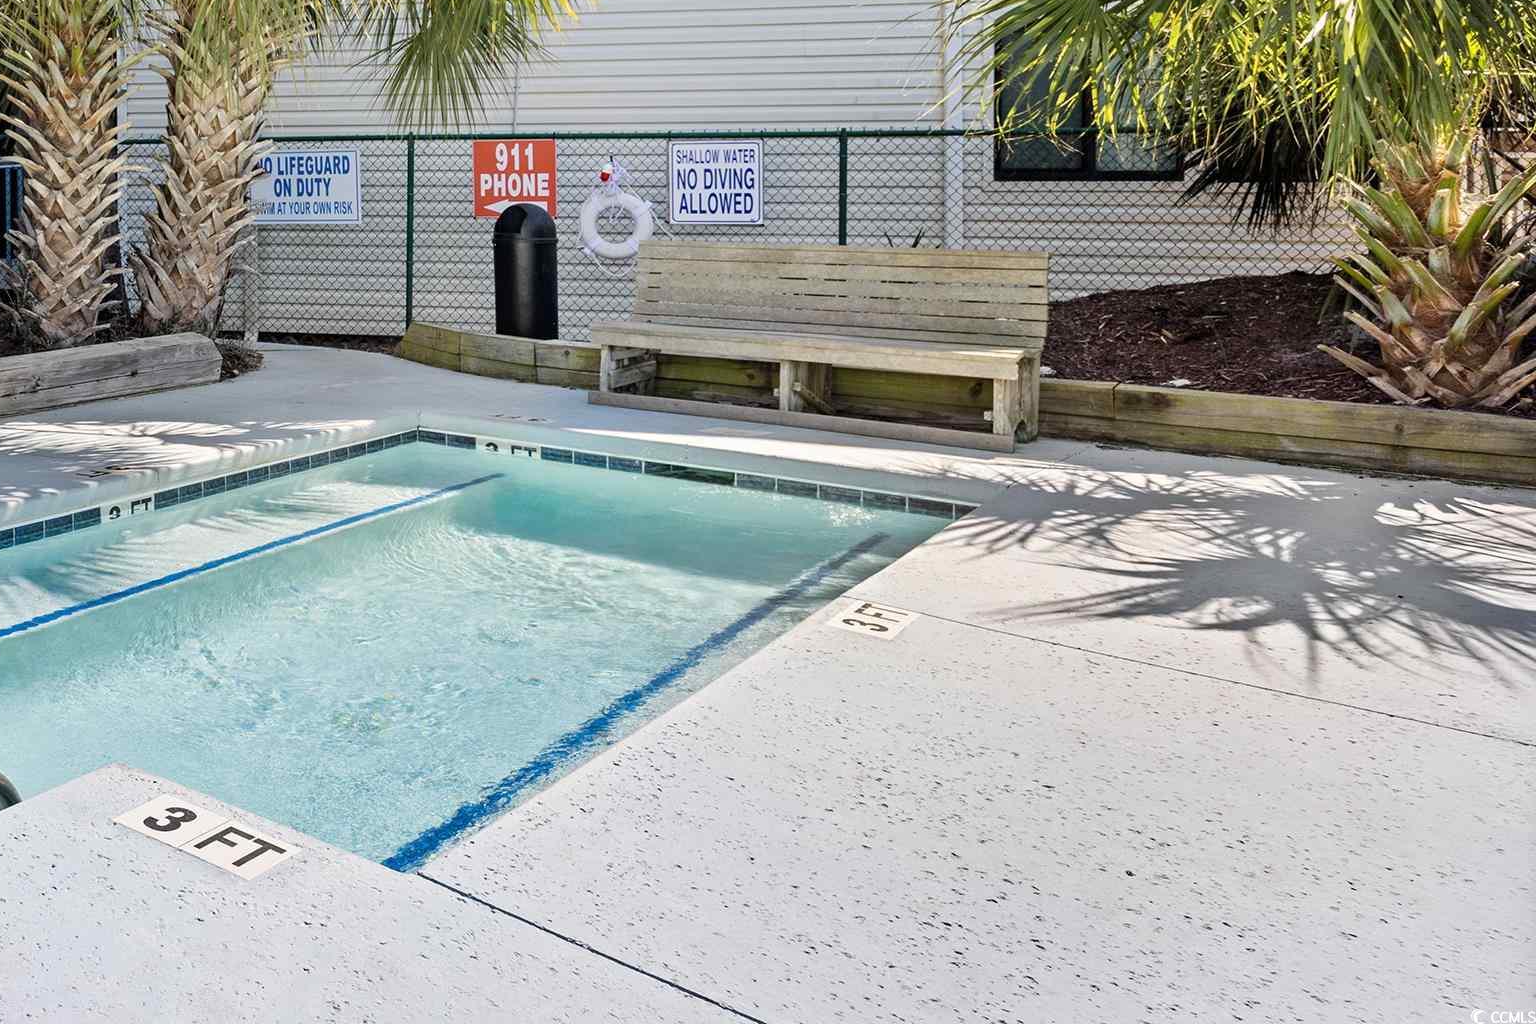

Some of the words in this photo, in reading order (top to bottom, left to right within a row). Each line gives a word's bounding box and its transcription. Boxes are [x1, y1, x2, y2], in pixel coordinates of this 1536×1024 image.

[277, 155, 350, 175] LIFEGUARD
[495, 142, 534, 171] 911
[676, 149, 720, 164] SHALLOW
[723, 148, 756, 164] WATER
[274, 178, 292, 197] ON
[296, 177, 332, 197] DUTY
[480, 173, 550, 197] PHONE
[677, 168, 698, 190] NO
[704, 167, 755, 190] DIVING
[277, 201, 287, 215] AT
[289, 201, 313, 215] YOUR
[313, 201, 332, 215] OWN
[334, 200, 353, 215] RISK
[679, 192, 754, 214] ALLOWED
[854, 603, 908, 623] FT
[842, 618, 889, 632] 3
[143, 807, 198, 832] 3
[193, 826, 287, 867] FT
